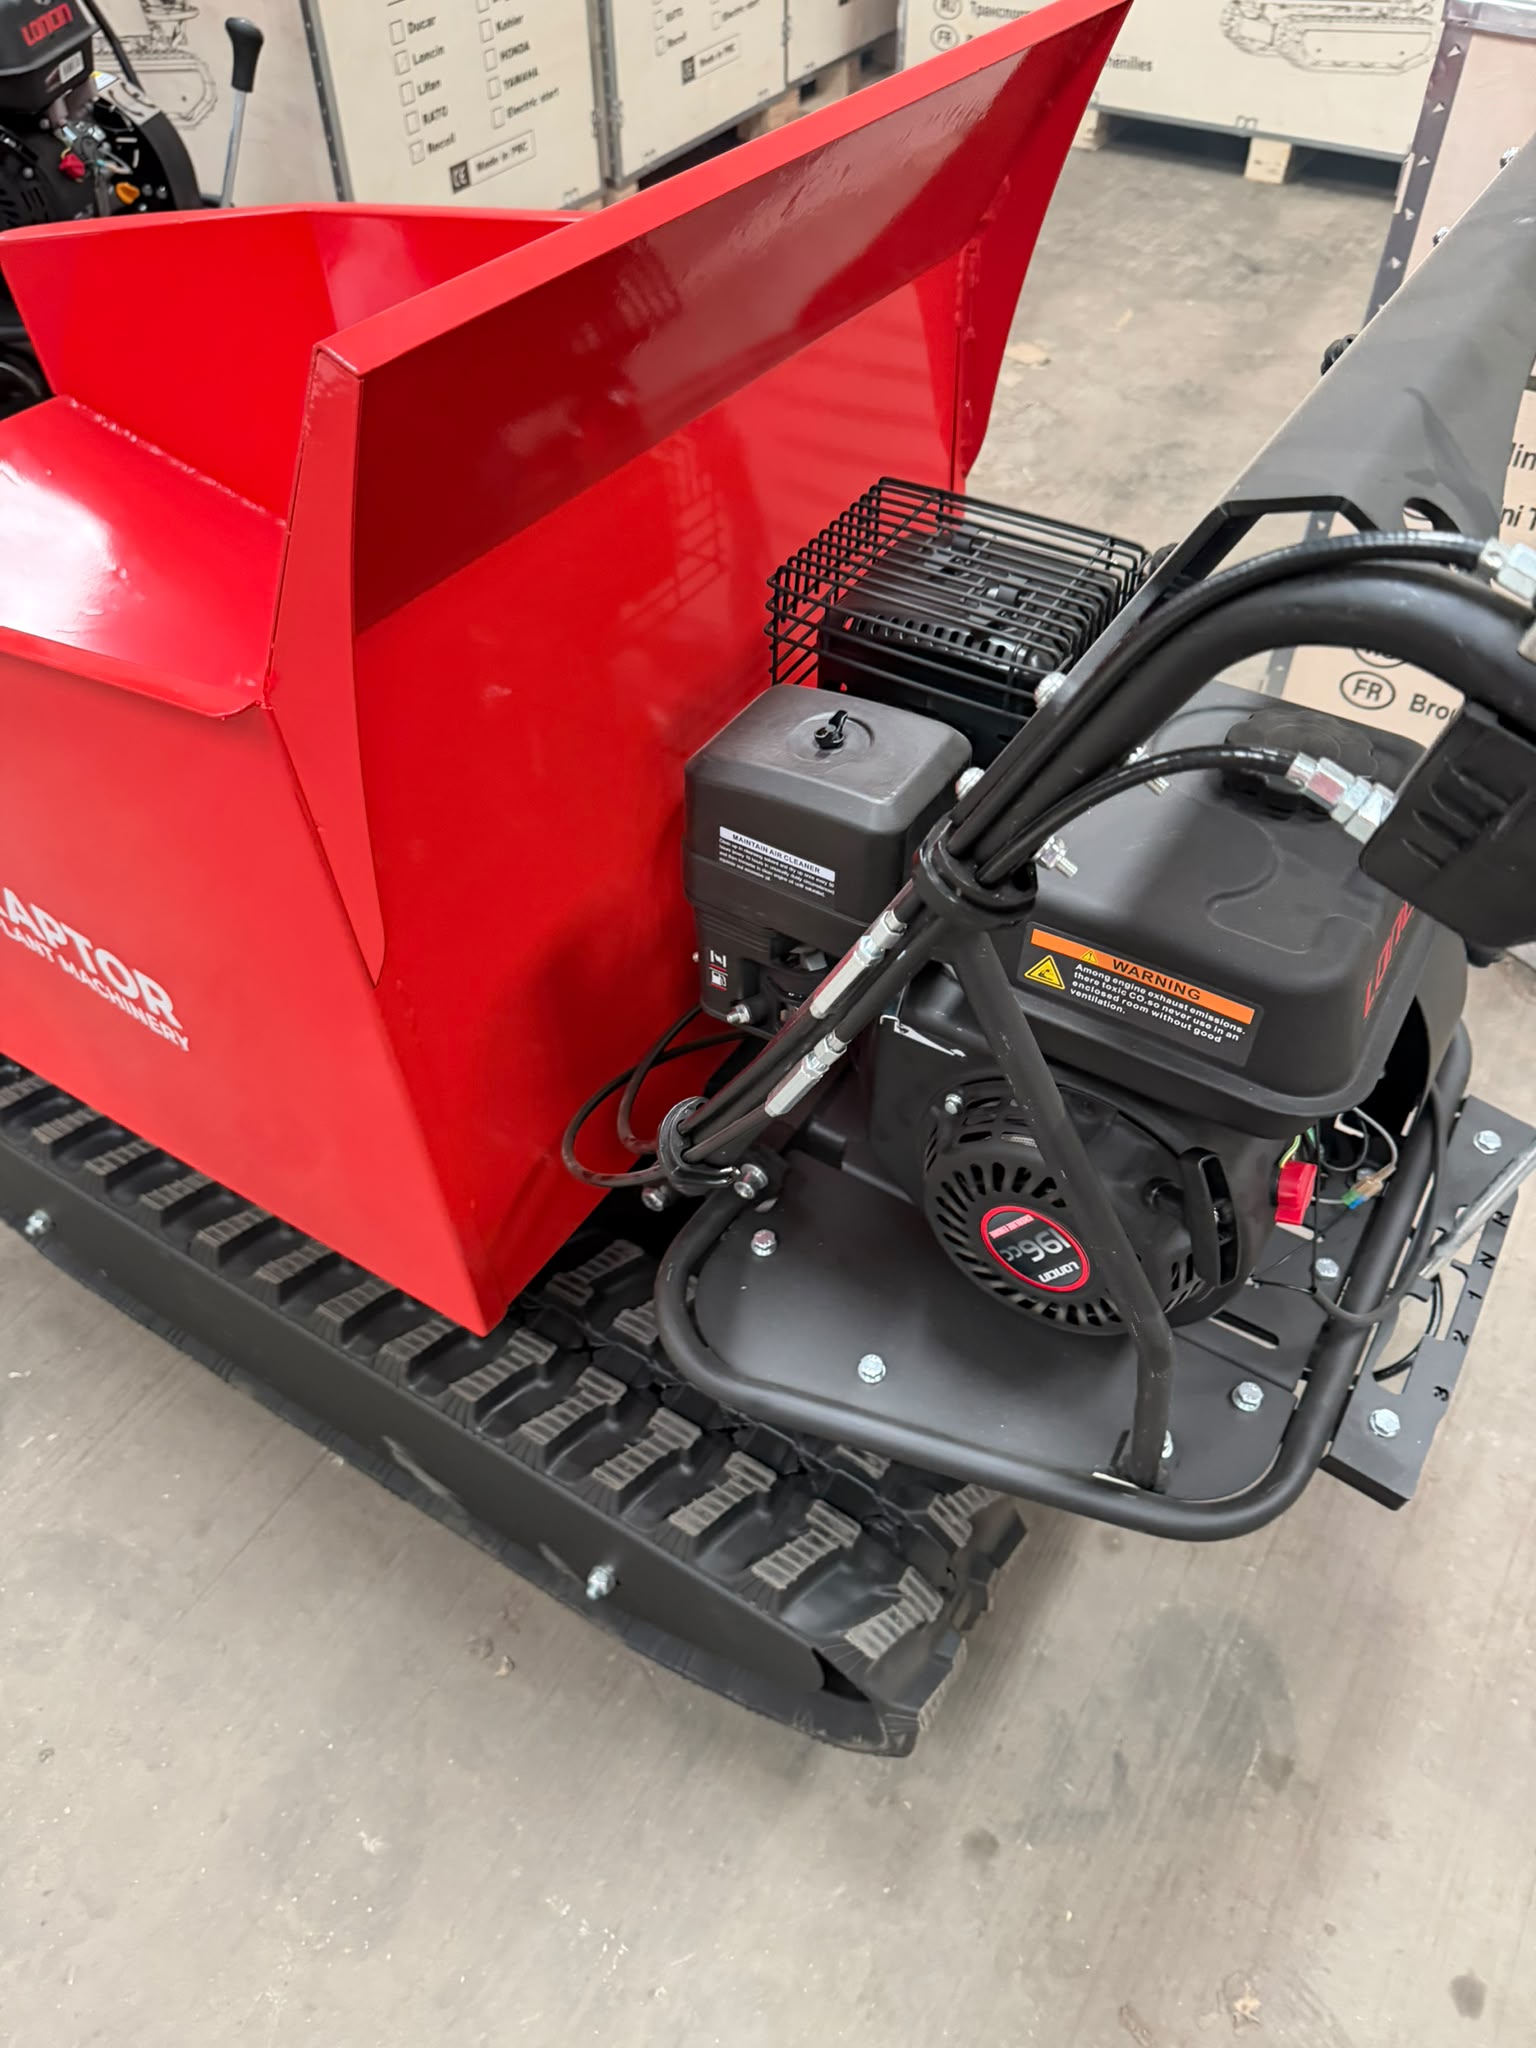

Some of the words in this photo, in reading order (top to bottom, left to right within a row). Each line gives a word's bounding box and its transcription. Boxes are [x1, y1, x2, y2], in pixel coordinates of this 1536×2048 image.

[1352, 678, 1384, 702] FR
[1408, 693, 1458, 721] Bro
[732, 834, 768, 853] MAINTAIN
[769, 849, 782, 859] AIR
[783, 854, 821, 874] CLEANER
[0, 887, 184, 1030] APTOR
[0, 917, 55, 963] LANT
[57, 954, 189, 1052] MACHINERY
[1075, 963, 1111, 982] Among
[1112, 977, 1146, 995] engine
[1147, 990, 1189, 1011] exhaust
[1189, 1006, 1246, 1035] emissions.
[1112, 959, 1201, 1001] WARNING
[1070, 988, 1126, 1014] ventilation.
[1072, 980, 1120, 1002] enclosed
[1121, 999, 1149, 1014] room
[1151, 1009, 1192, 1031] without
[1193, 1027, 1222, 1043] good
[1074, 971, 1100, 986] there
[1101, 982, 1127, 997] toxic
[1161, 1005, 1192, 1021] never
[1192, 1016, 1212, 1029] use
[1213, 1025, 1224, 1035] in
[1225, 1031, 1240, 1041] an
[1492, 1210, 1510, 1228] R
[999, 1227, 1071, 1263] 196cc
[1478, 1250, 1496, 1269] N
[1038, 1261, 1080, 1283] LONCIN
[1467, 1289, 1482, 1300] 1
[1452, 1329, 1470, 1346] 2
[1433, 1386, 1450, 1402] 3
